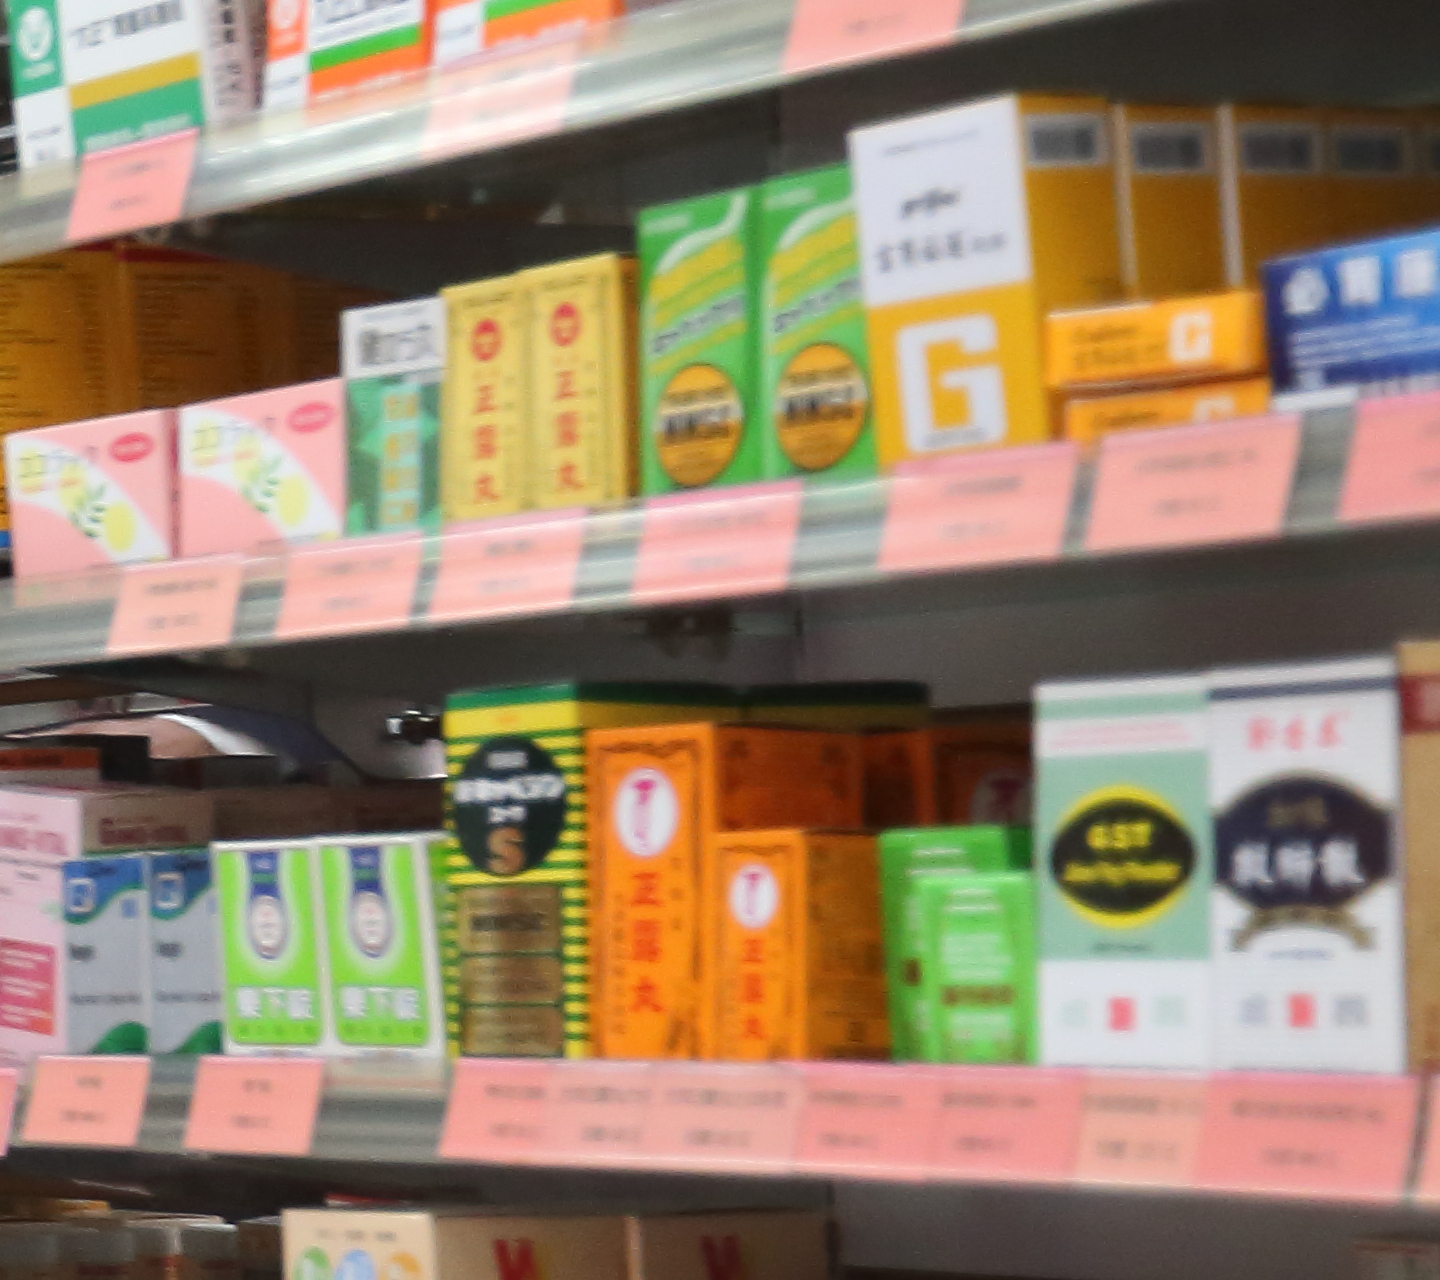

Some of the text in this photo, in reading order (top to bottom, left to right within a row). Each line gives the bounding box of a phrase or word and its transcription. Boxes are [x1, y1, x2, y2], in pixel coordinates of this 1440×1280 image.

[894, 312, 1009, 452] G
[630, 872, 664, 1016] 正露丸
